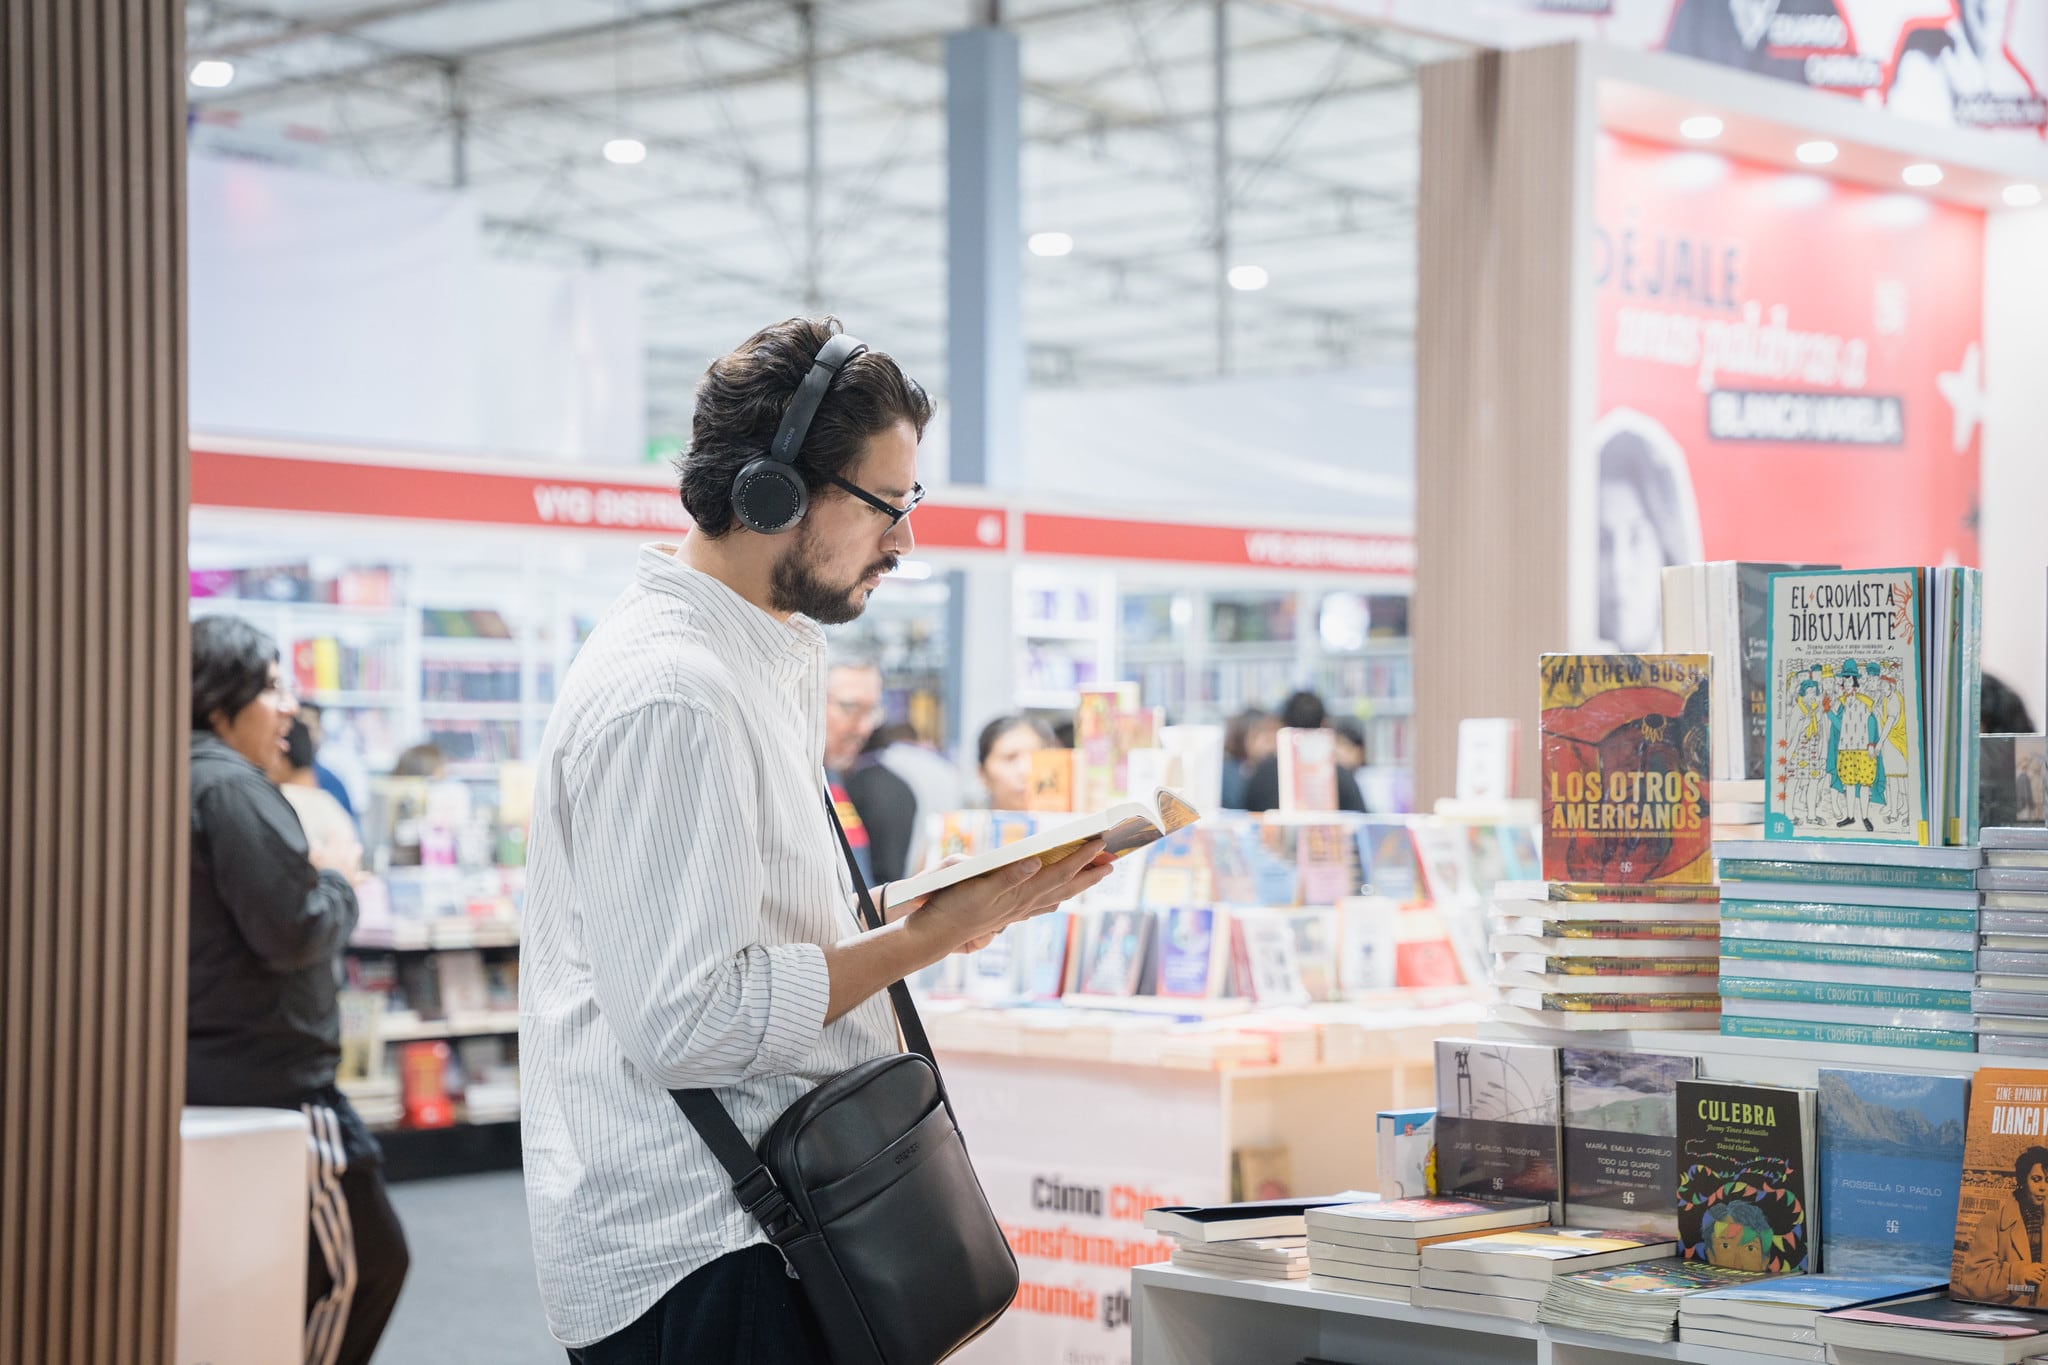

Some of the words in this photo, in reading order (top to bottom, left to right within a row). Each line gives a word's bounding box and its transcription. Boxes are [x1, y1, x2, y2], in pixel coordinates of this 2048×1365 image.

[1792, 586, 1809, 609] EL
[1816, 580, 1896, 608] CRONISTA
[1789, 609, 1896, 642] DIBUJANTE
[1551, 663, 1641, 684] MATTHEW
[1650, 663, 1699, 683] BUSH
[1551, 771, 1602, 803] LOS
[1610, 771, 1701, 803] OTROS
[1551, 803, 1701, 830] AMERICANOS
[1698, 1099, 1777, 1127] CULEBRA
[1991, 1105, 2040, 1136] BLANCA
[1598, 1157, 1616, 1165] TODO
[1610, 1144, 1633, 1153] EMILIA
[1636, 1147, 1672, 1157] CORNEJO
[1842, 1179, 1892, 1193] ROSSELLA
[1895, 1184, 1905, 1193] DI
[1909, 1185, 1943, 1197] PAOLO
